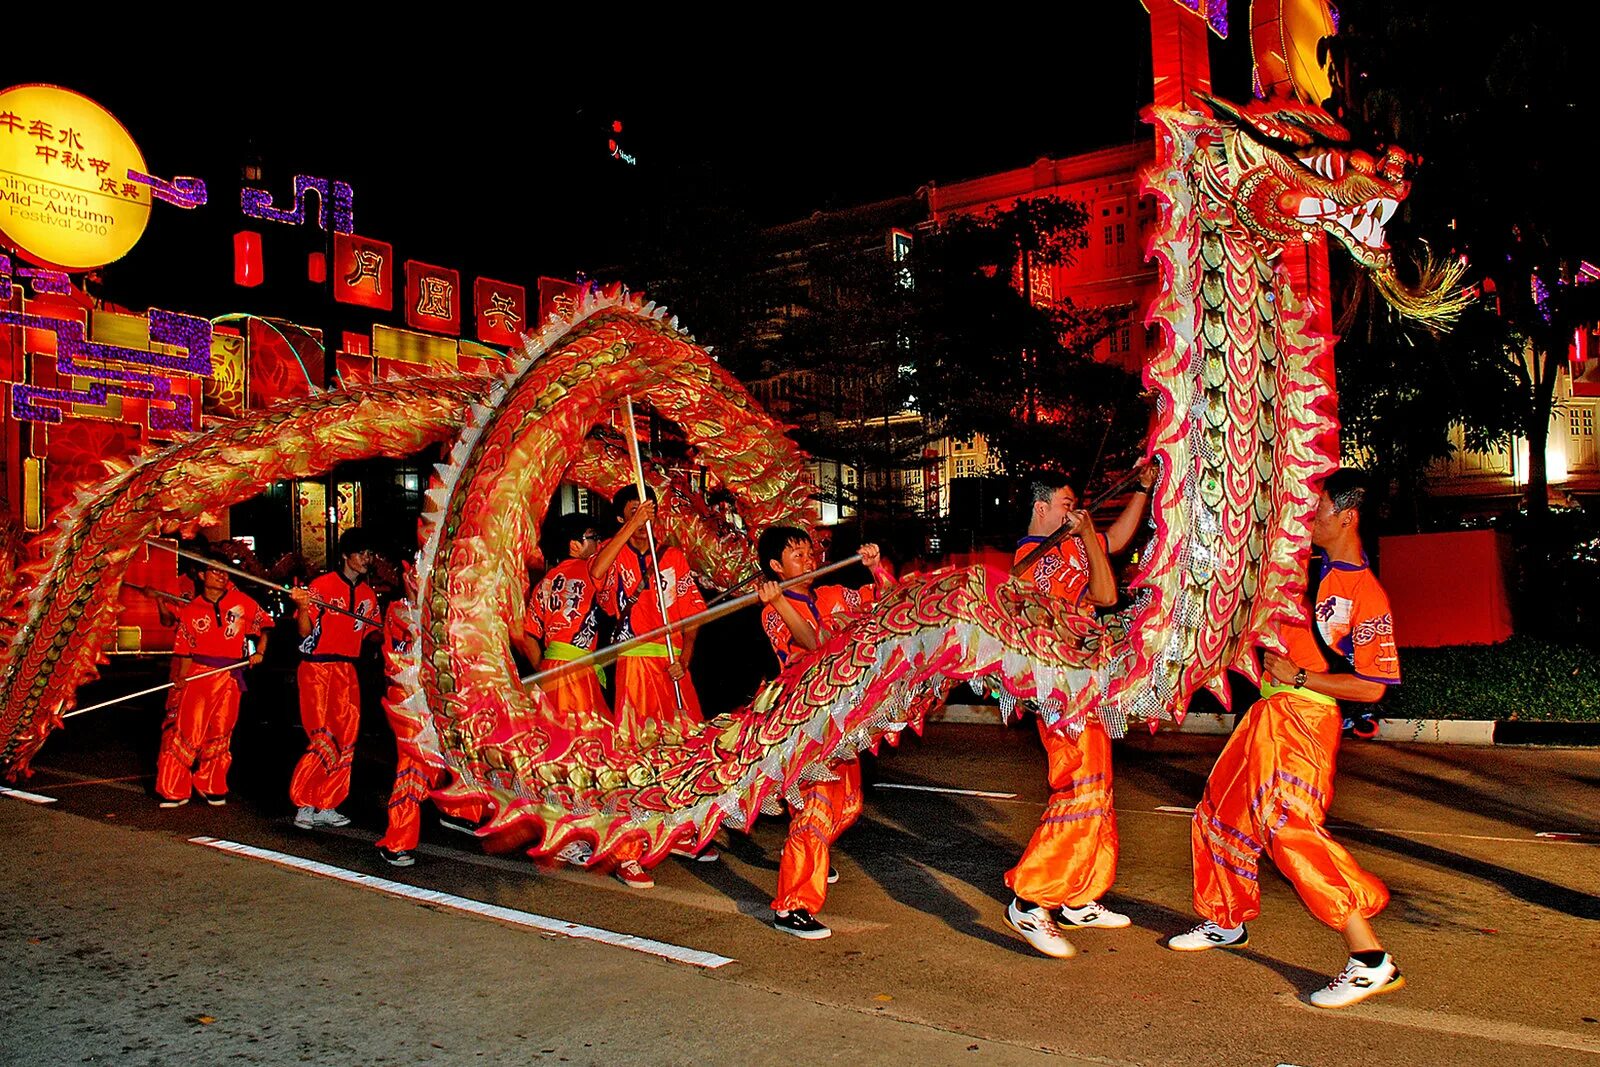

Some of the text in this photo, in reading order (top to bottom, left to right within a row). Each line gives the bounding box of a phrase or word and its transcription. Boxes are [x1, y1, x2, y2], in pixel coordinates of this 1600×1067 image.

[0, 111, 84, 150] 牛车水
[35, 145, 111, 176] 中秋节
[98, 178, 140, 199] 庆典
[0, 189, 115, 225] Mid-Autumn
[10, 206, 108, 236] Festival 2010
